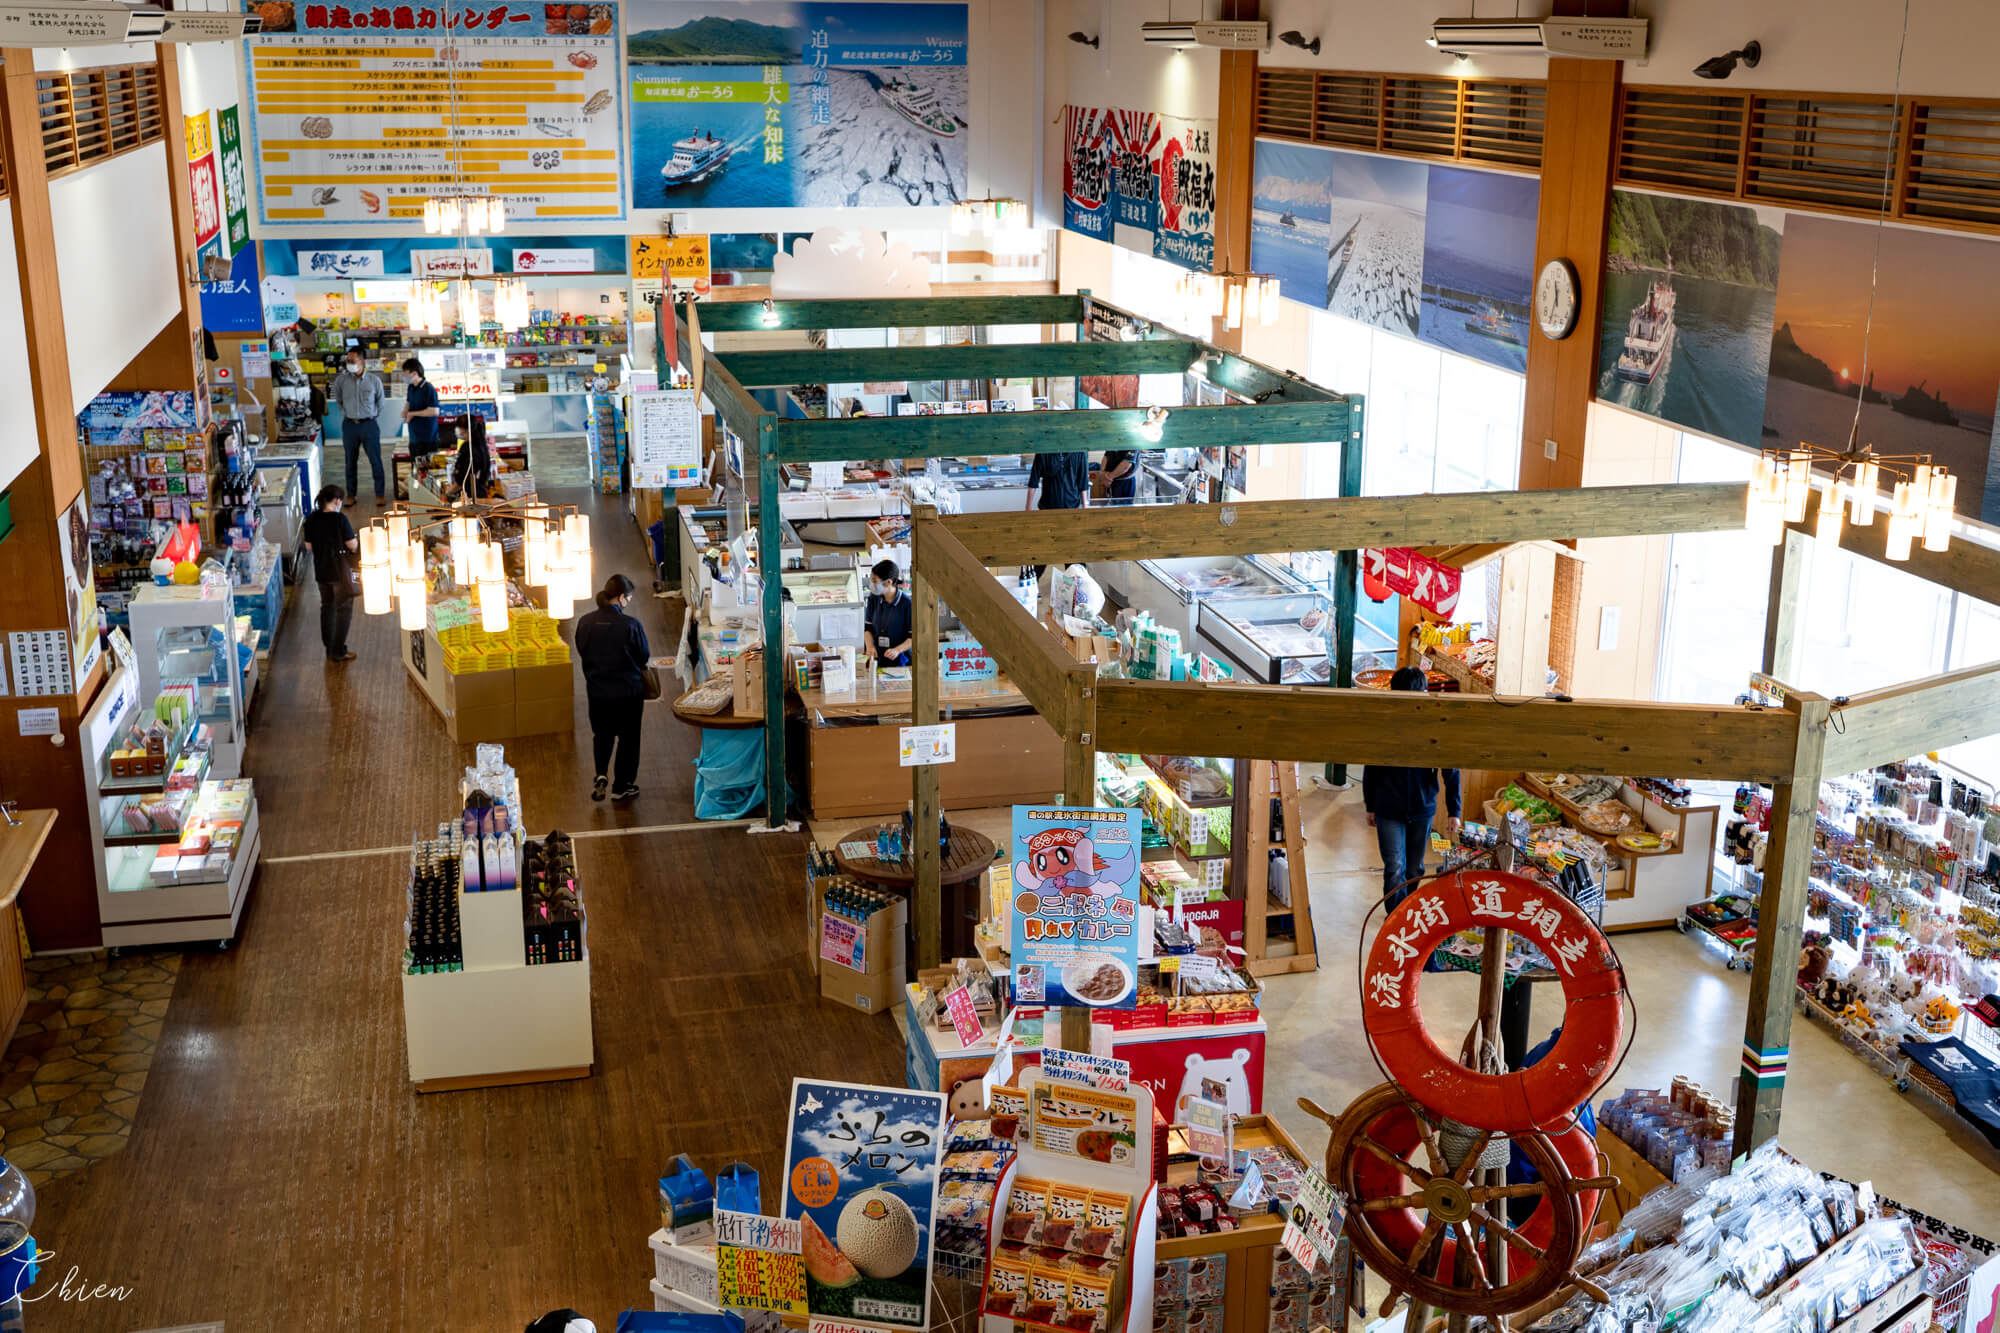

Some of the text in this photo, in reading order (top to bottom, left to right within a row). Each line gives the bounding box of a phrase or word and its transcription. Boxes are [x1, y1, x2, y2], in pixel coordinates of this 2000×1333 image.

[305, 5, 531, 29] 網走のお魚カレンダー
[926, 37, 964, 48] Winter
[908, 50, 953, 62] おーろら
[636, 73, 682, 84] Summer
[811, 30, 831, 125] 迫力の網走
[687, 86, 734, 98] おーろら
[762, 65, 784, 165] 雄大な知床
[637, 256, 705, 269] インカのめざめ
[1367, 548, 1458, 614] ラーメン
[1040, 893, 1107, 917] ニポネ
[1183, 909, 1219, 921] HOGAJA
[1077, 918, 1131, 940] カレー
[826, 1090, 938, 1107] FURANO MELON
[1042, 1099, 1133, 1124] エミューカレー
[828, 1111, 931, 1148] ふらの
[840, 1146, 917, 1174] メロン
